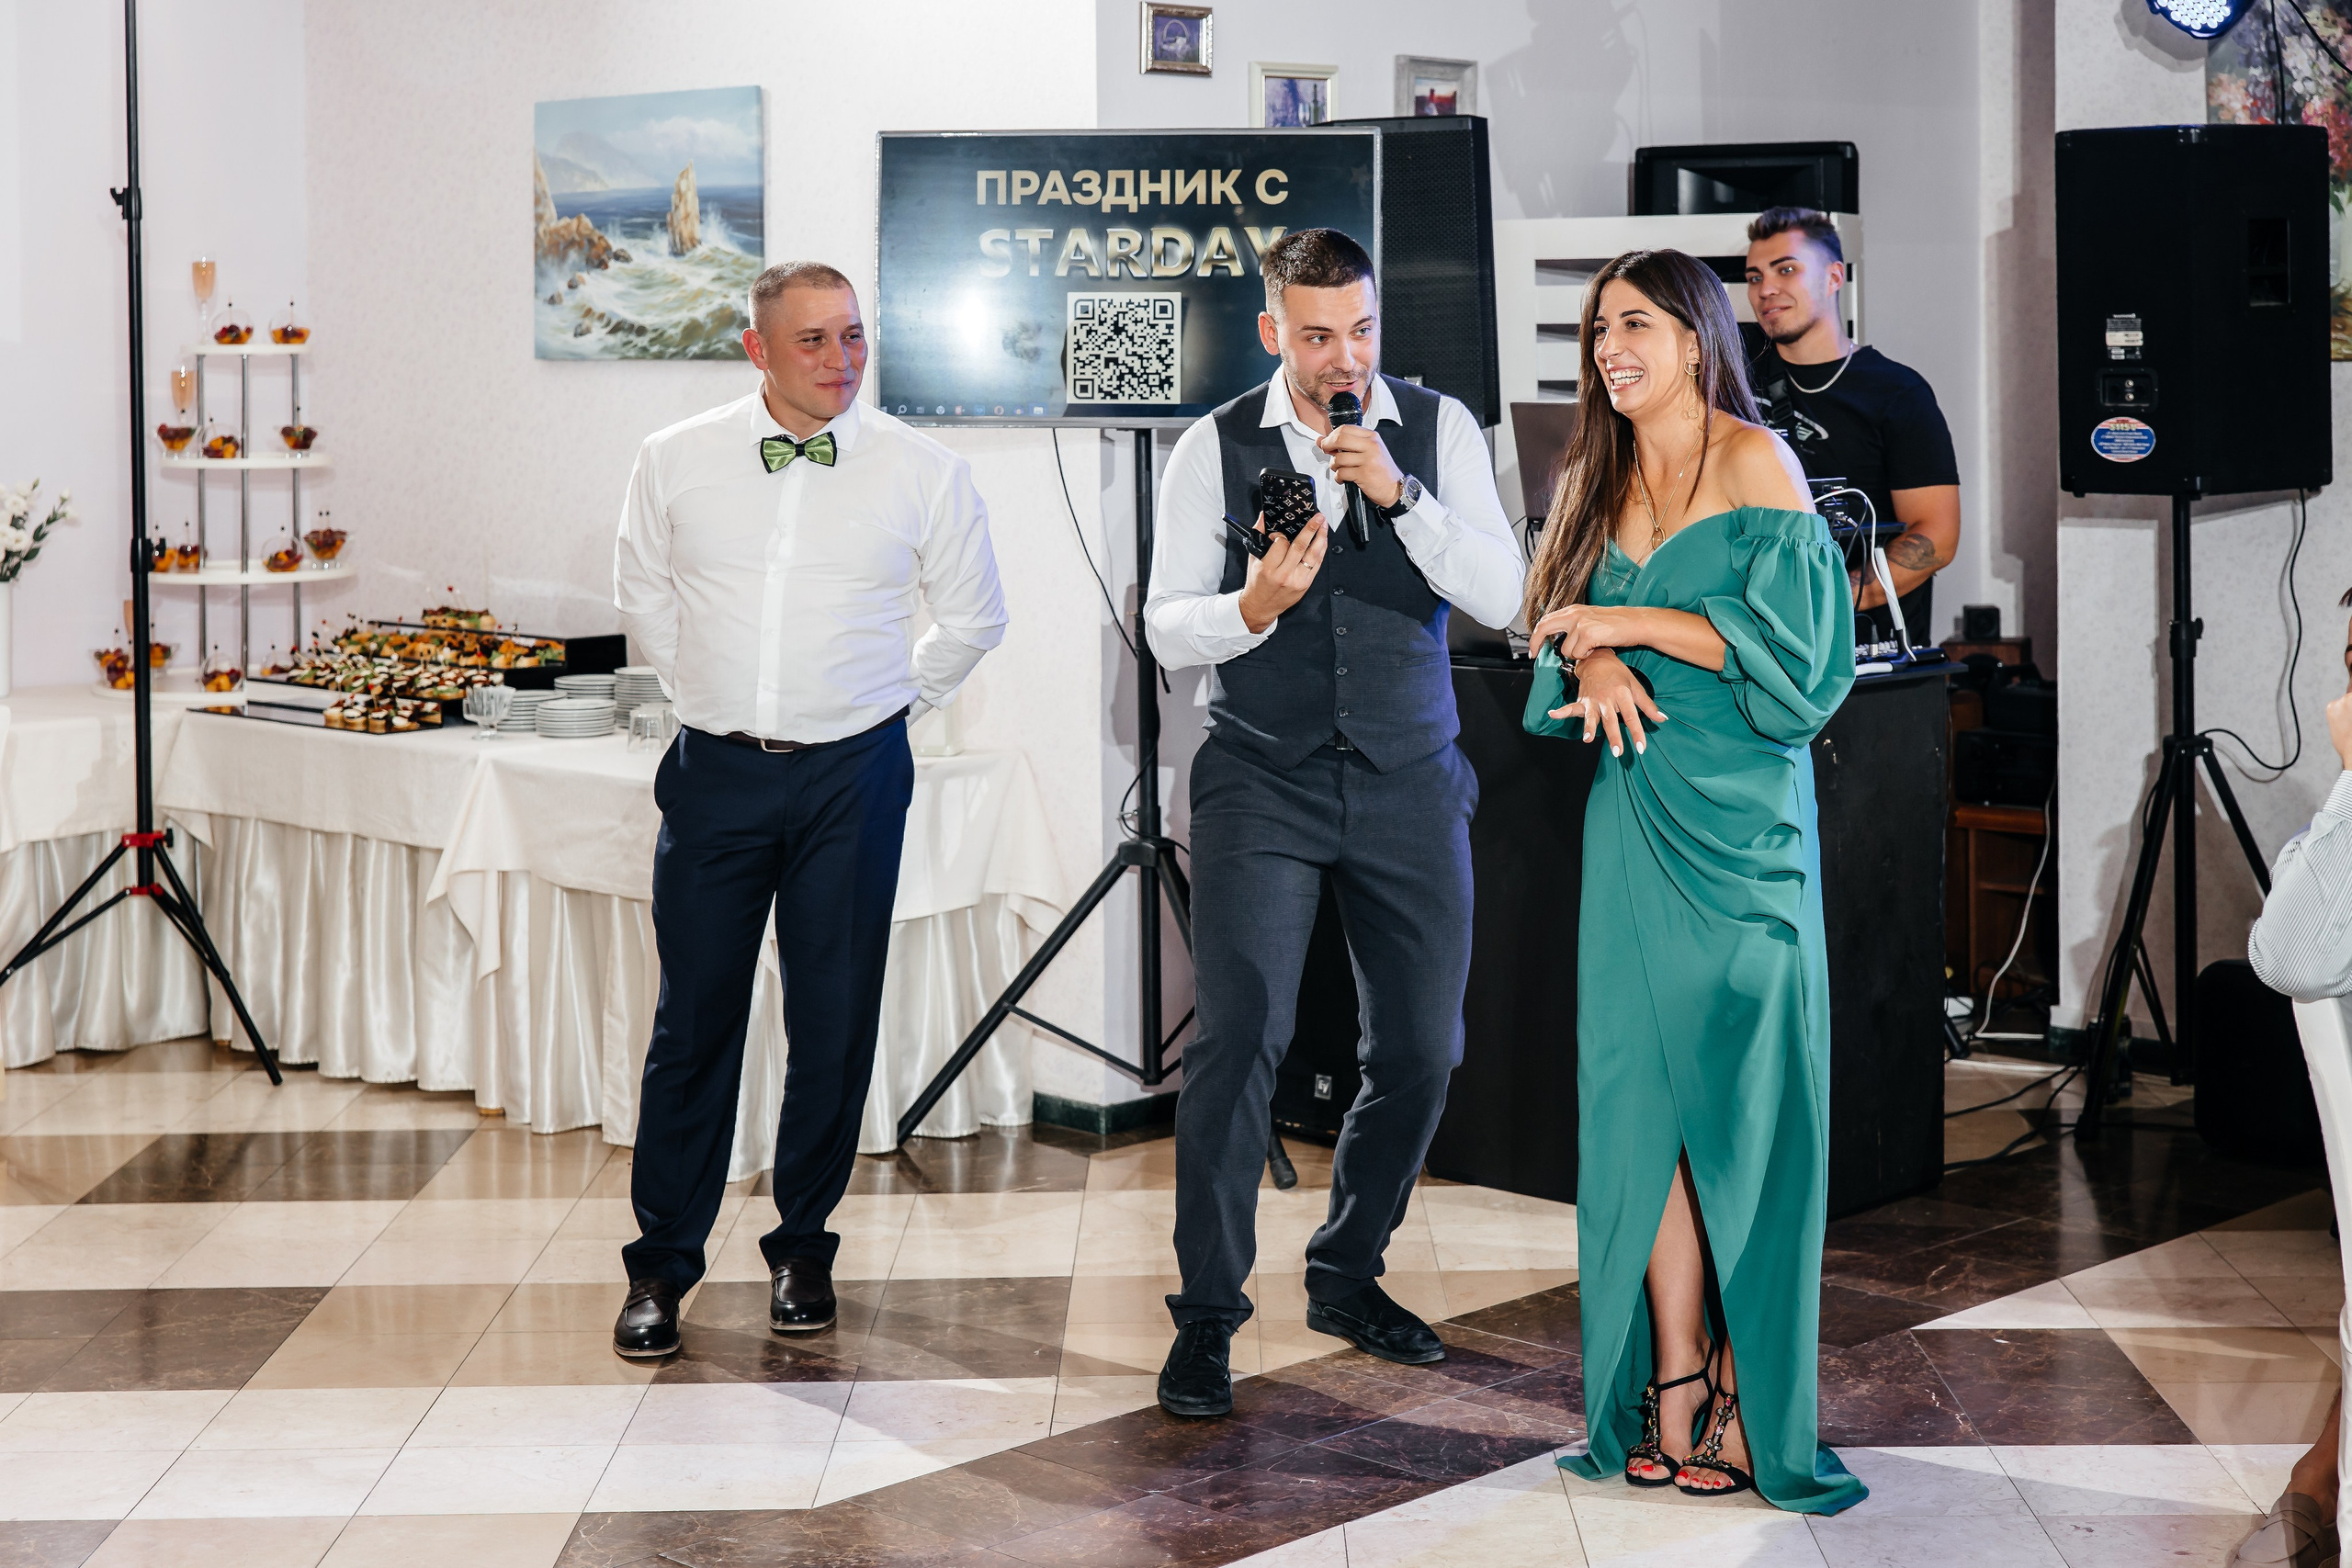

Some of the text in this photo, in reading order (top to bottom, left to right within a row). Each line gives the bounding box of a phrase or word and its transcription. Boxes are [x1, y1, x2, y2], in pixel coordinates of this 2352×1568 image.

[976, 168, 1289, 213] ПРАЗДНИК С
[978, 227, 1288, 278] STARDAY
